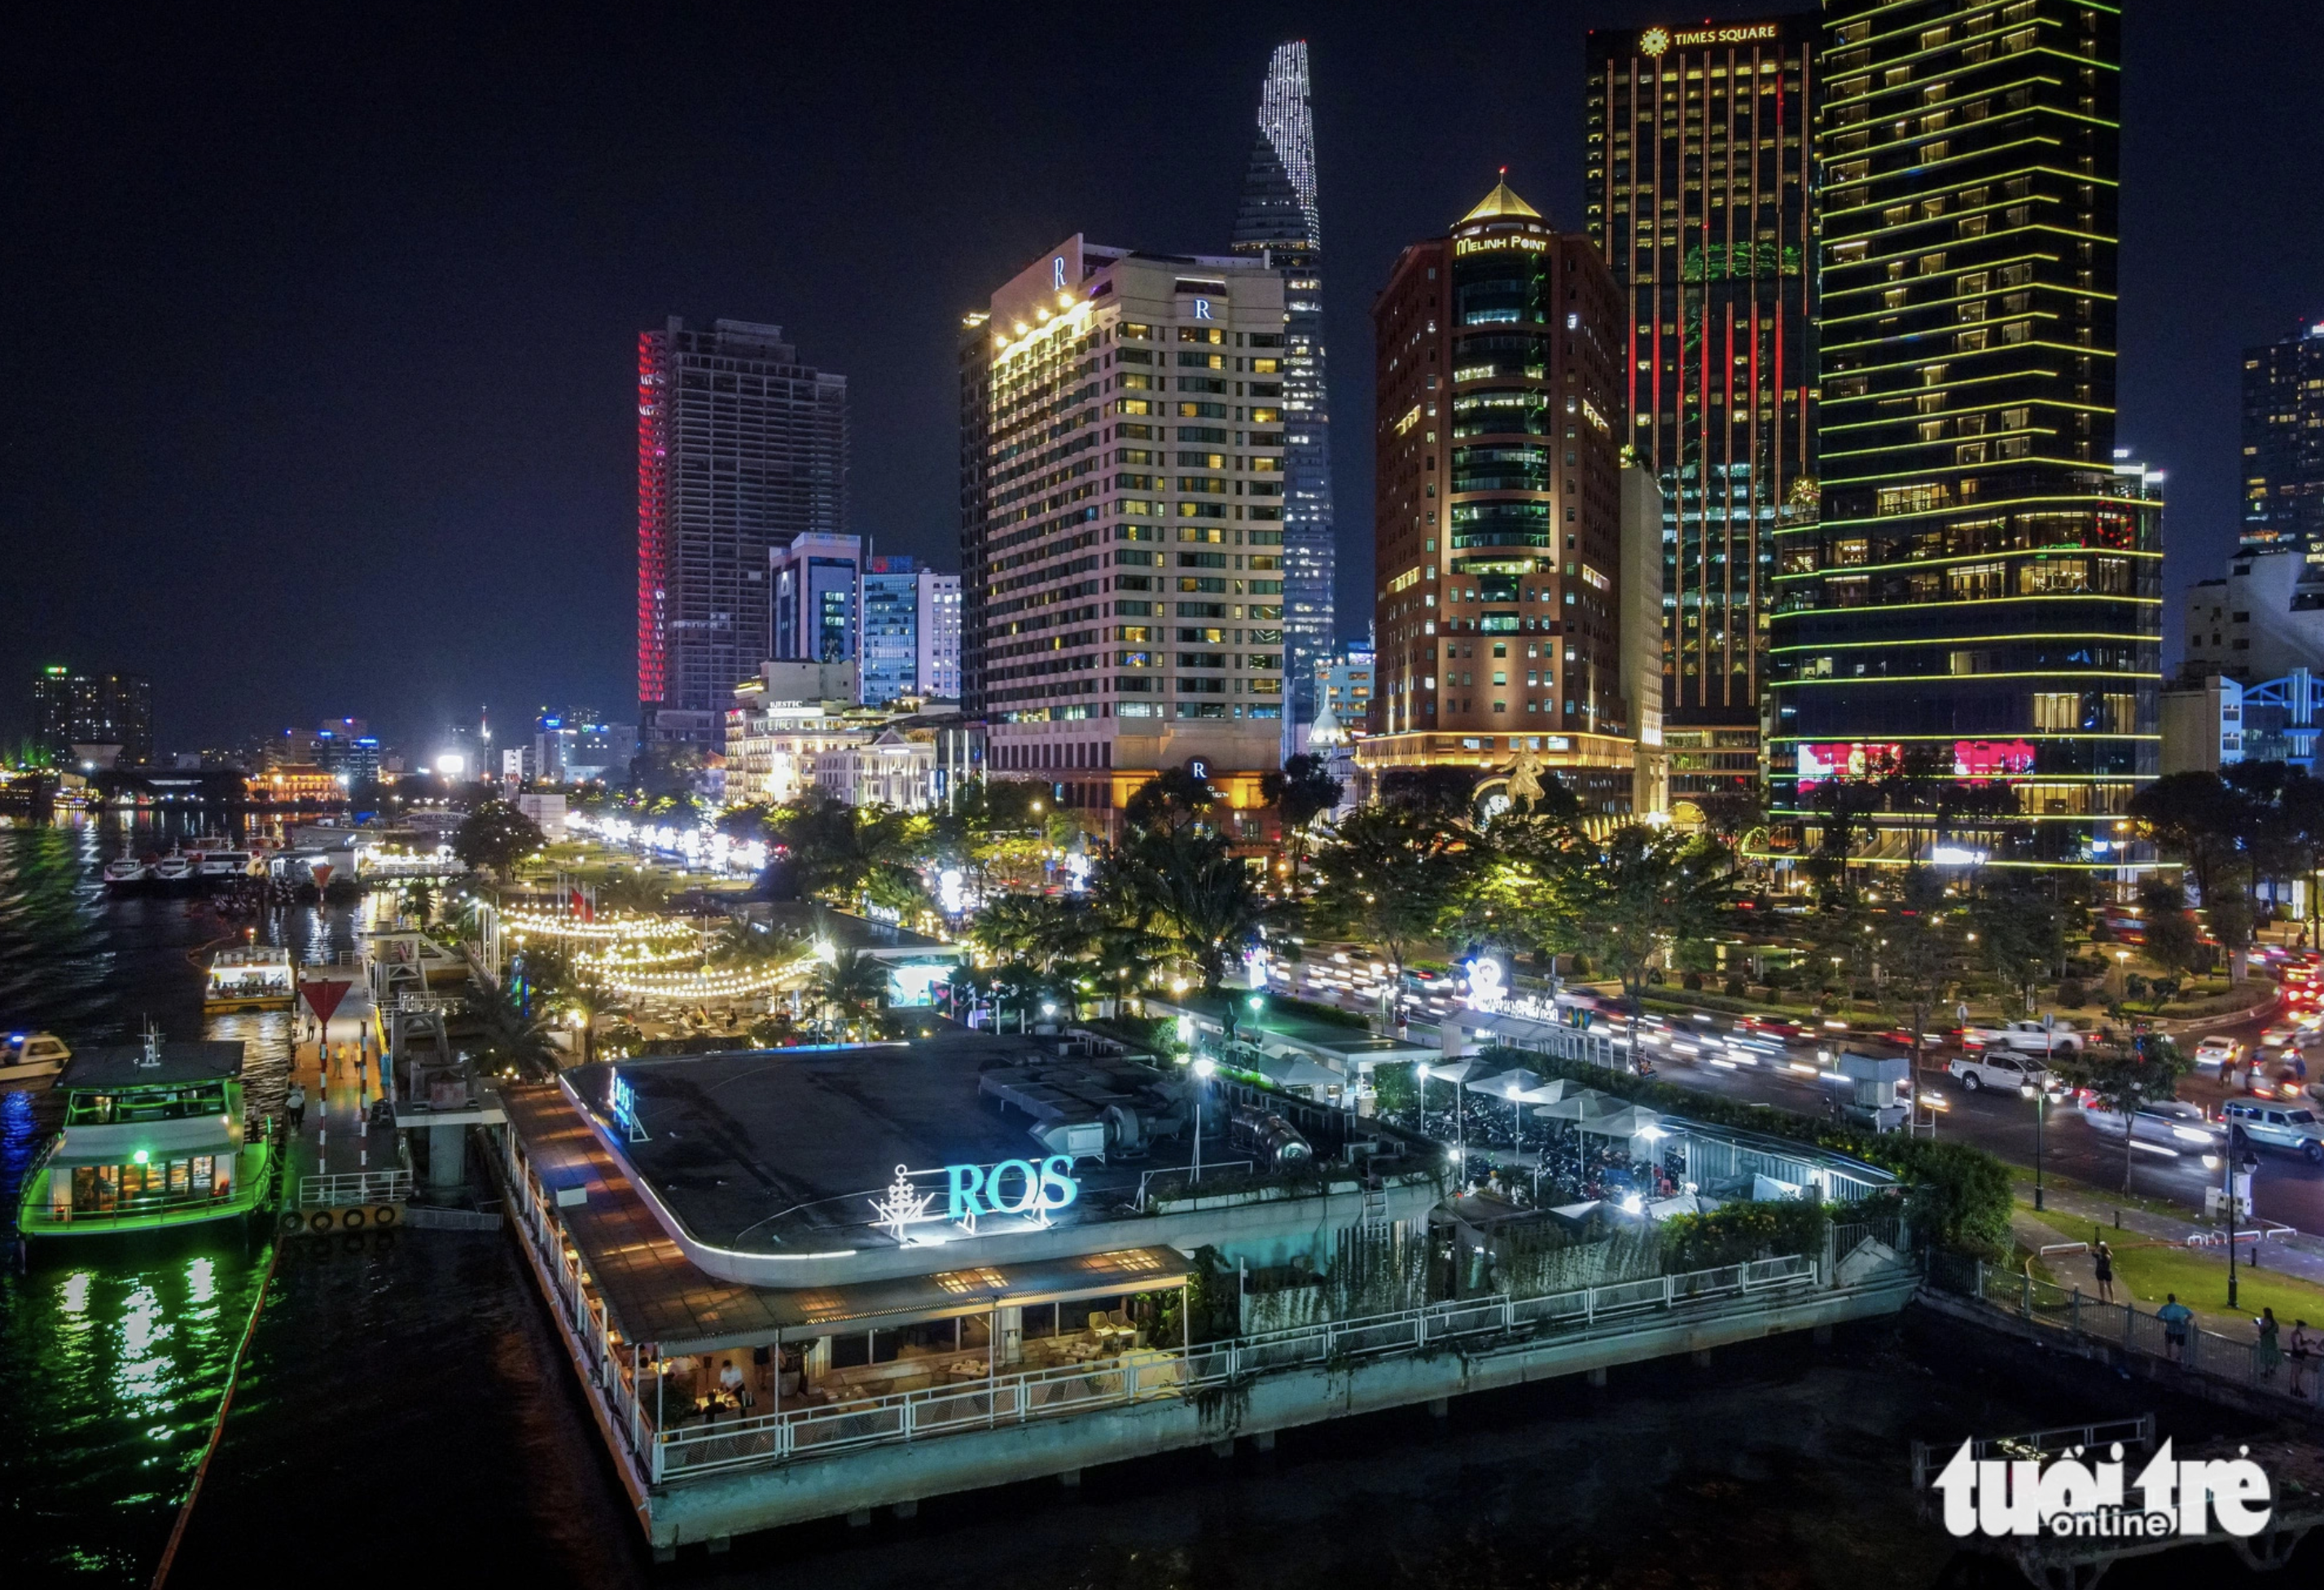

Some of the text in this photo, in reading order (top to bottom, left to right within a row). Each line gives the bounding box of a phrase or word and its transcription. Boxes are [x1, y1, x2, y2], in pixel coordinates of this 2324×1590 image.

[1674, 26, 1775, 45] TIMES SQUARE
[1054, 257, 1068, 291] R
[1195, 299, 1213, 319] R
[1193, 762, 1208, 778] R
[944, 1154, 1077, 1219] ROS
